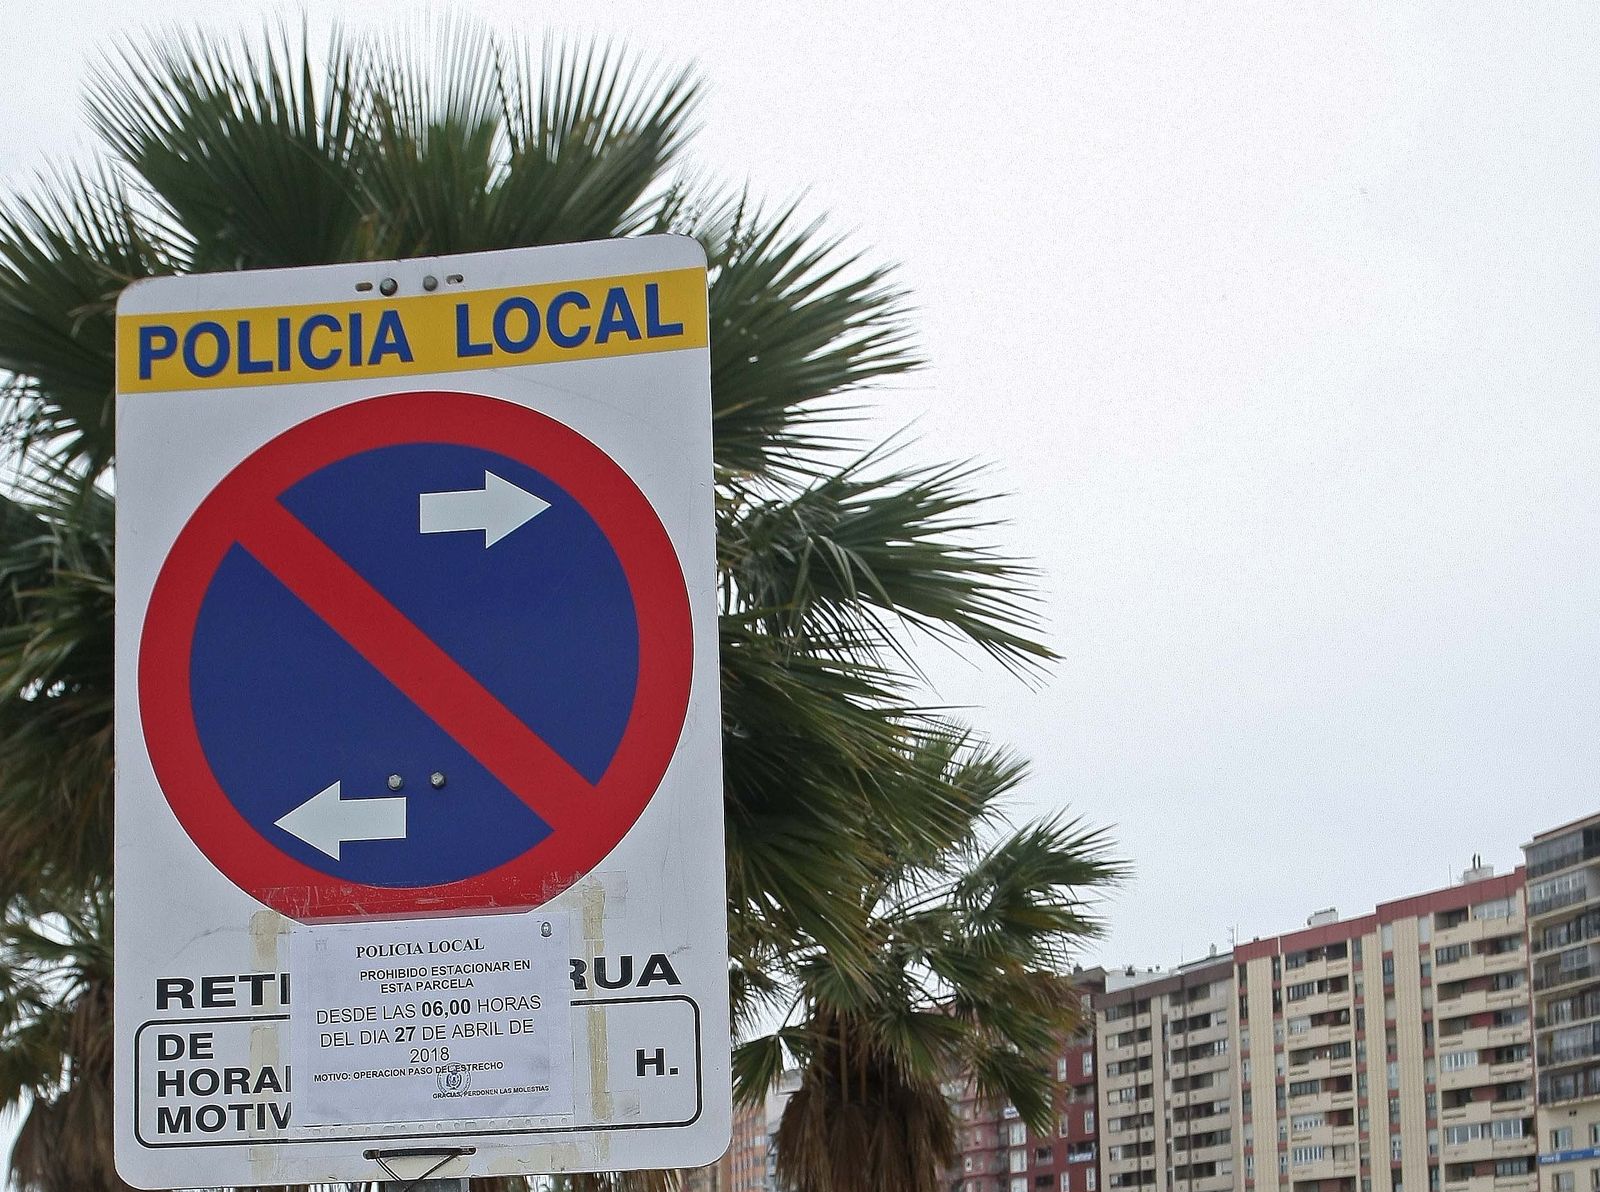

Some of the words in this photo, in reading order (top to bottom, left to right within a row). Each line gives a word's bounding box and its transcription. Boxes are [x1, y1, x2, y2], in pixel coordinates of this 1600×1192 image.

[138, 311, 414, 380] POLICIA
[456, 283, 684, 358] LOCAL
[356, 943, 423, 958] POLICIA
[428, 938, 485, 953] LOCAL
[360, 967, 428, 981] PROHIBIDO
[431, 961, 511, 977] ESTACIONAR
[514, 960, 531, 970] EN
[156, 972, 290, 1011] RETI
[381, 982, 413, 994] ESTA
[416, 978, 474, 992] PARCELA
[317, 1006, 377, 1025] DESDE
[383, 1004, 416, 1020] LAS
[421, 999, 471, 1019] 06,00
[478, 995, 541, 1012] HORAS
[157, 1033, 214, 1061] DE
[320, 1032, 355, 1048] DEL
[360, 1029, 389, 1045] DIA
[394, 1026, 416, 1043] 27
[422, 1025, 446, 1041] DE
[451, 1021, 504, 1039] ABRIL
[509, 1019, 534, 1035] DE
[410, 1047, 450, 1063] 2018
[157, 1065, 291, 1098] HORA
[635, 1048, 679, 1077] H.
[314, 1072, 351, 1082] MOTIVO:
[353, 1068, 406, 1080] OPERACION
[408, 1066, 433, 1076] PASO
[435, 1064, 453, 1075] DEL
[453, 1062, 504, 1073] ESTRECHO
